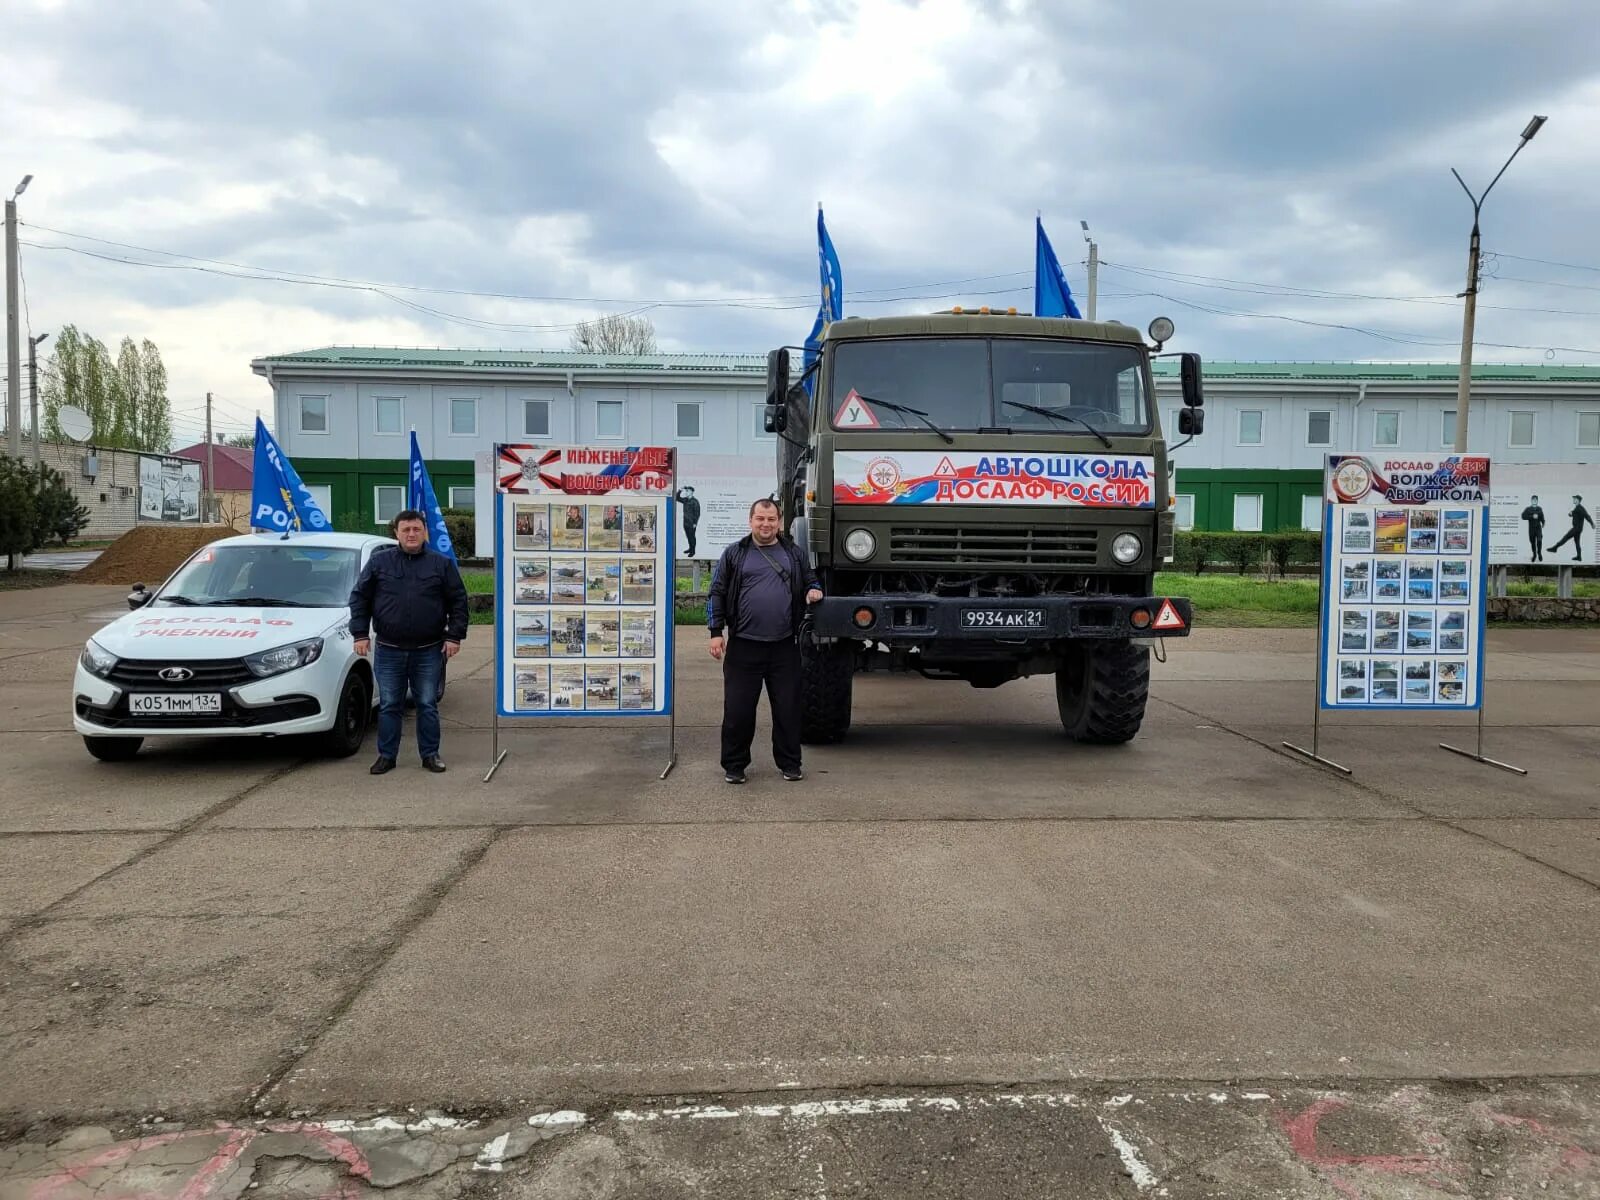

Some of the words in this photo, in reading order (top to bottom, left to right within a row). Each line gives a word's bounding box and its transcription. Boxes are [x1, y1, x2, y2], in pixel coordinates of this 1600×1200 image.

[567, 449, 668, 466] ИНЖЕНЕРНЫЕ
[976, 456, 1149, 480] АВТОШКОЛА
[1383, 460, 1434, 472] ДОСААФ
[1439, 461, 1487, 473] РОССИИ
[566, 472, 620, 490] ВОЙСКА
[623, 474, 642, 490] ВС
[645, 475, 668, 491] РФ
[1390, 474, 1479, 487] ВОЛЖСКАЯ
[936, 480, 1046, 502] ДОСААФ
[1052, 482, 1150, 503] РОССИИ
[1384, 488, 1484, 502] АВТОШКОЛА
[136, 616, 293, 627] ДОСААФ
[1027, 611, 1042, 622] 21
[135, 627, 259, 638] УЧЕБНЫЙ
[194, 695, 217, 706] 134
